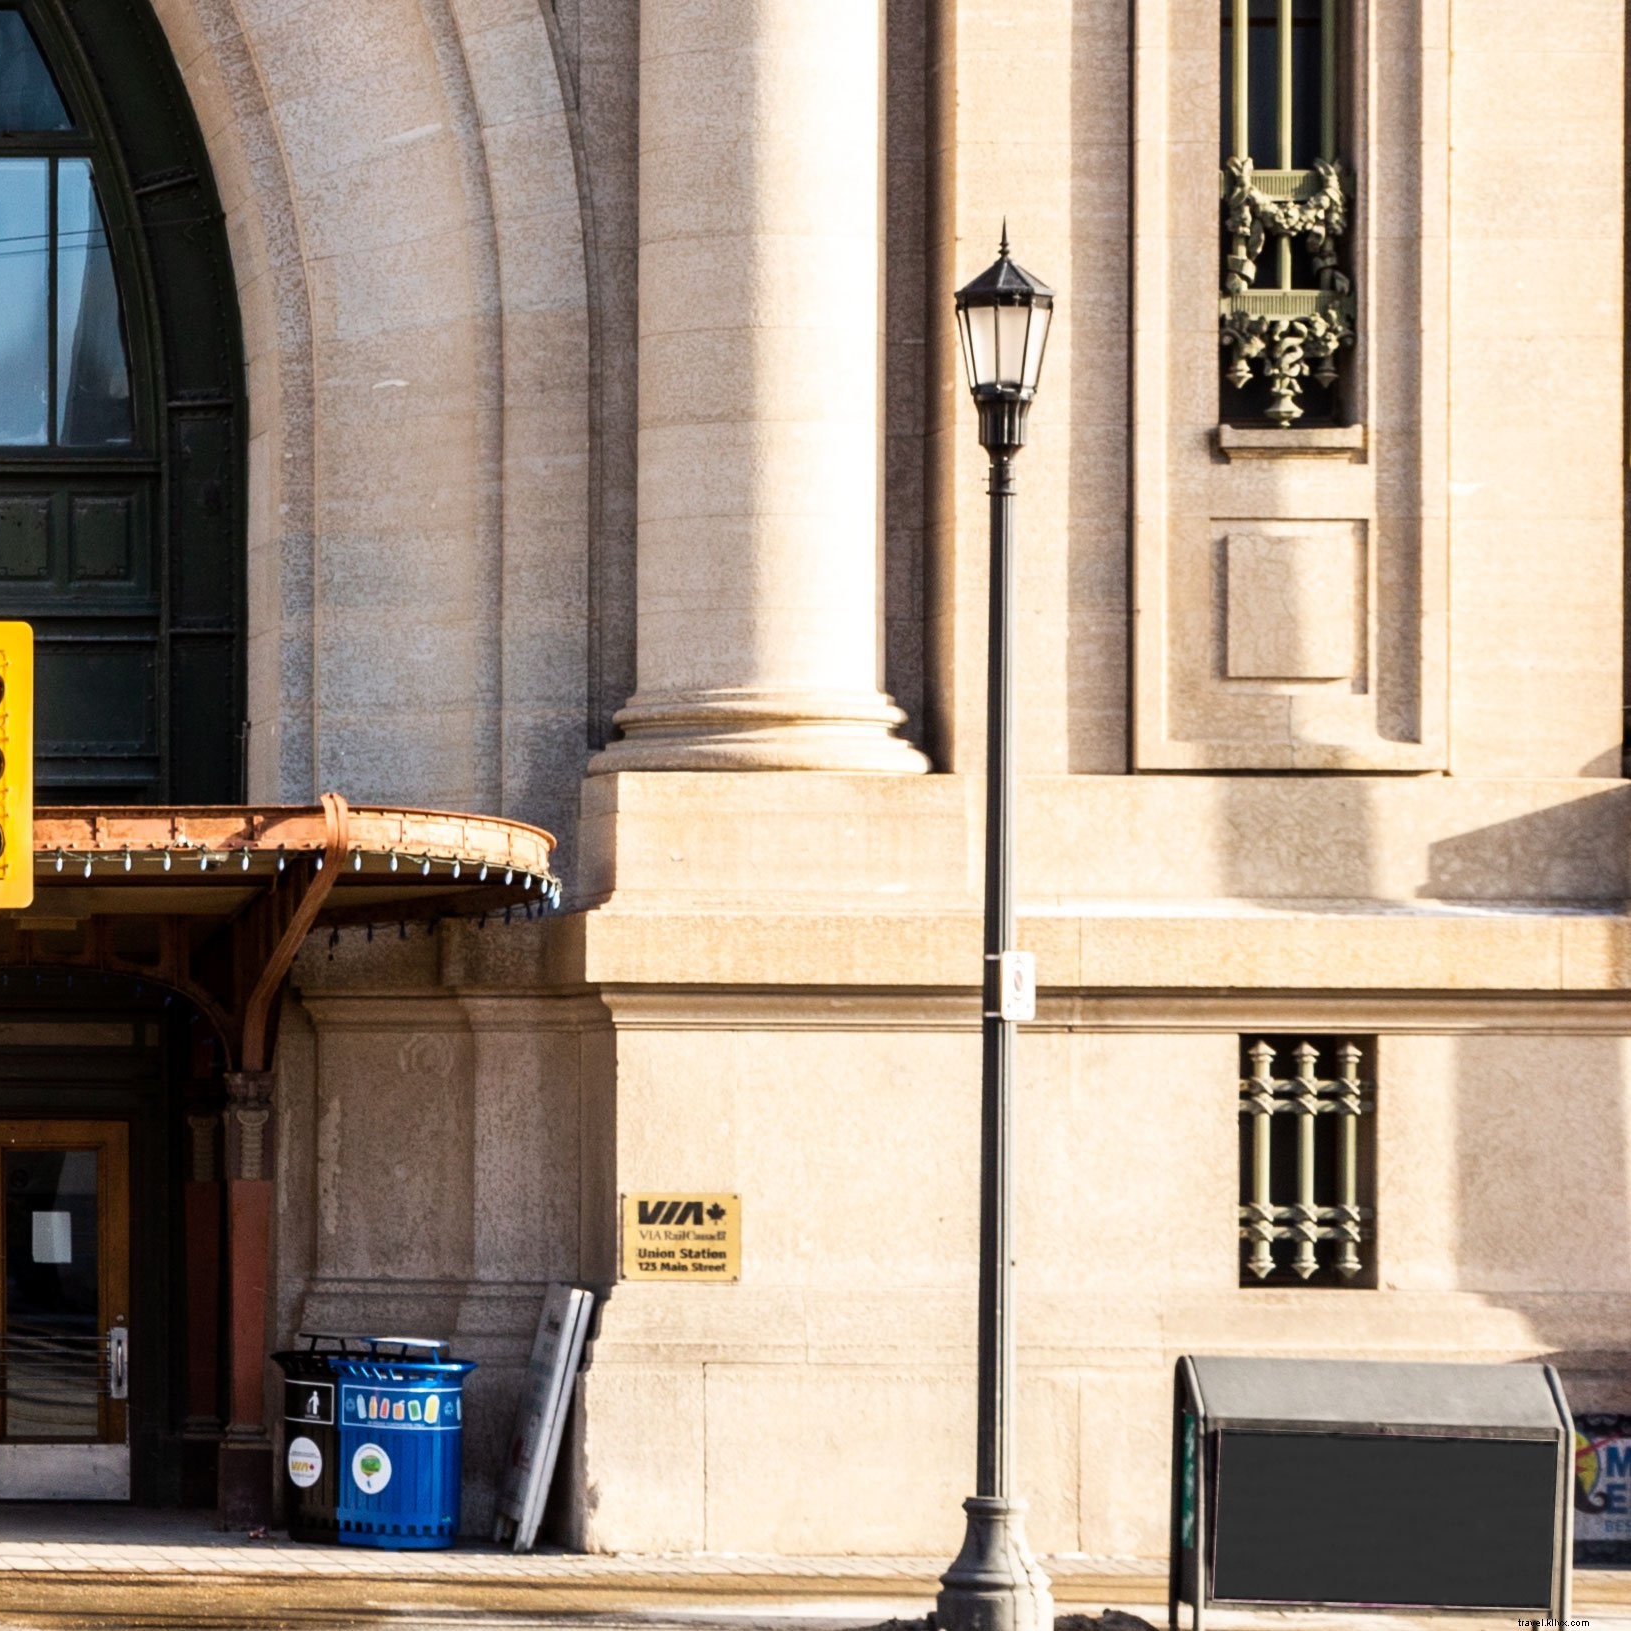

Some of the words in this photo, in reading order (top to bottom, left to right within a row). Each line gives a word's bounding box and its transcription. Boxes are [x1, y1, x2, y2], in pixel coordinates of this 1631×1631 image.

[638, 1200, 704, 1225] VIA
[639, 1230, 662, 1240] VIA
[665, 1230, 687, 1241] Rail
[638, 1248, 675, 1259] Union
[680, 1248, 727, 1259] Station
[638, 1262, 657, 1271] 123
[660, 1262, 688, 1272] Main
[691, 1262, 726, 1272] Street
